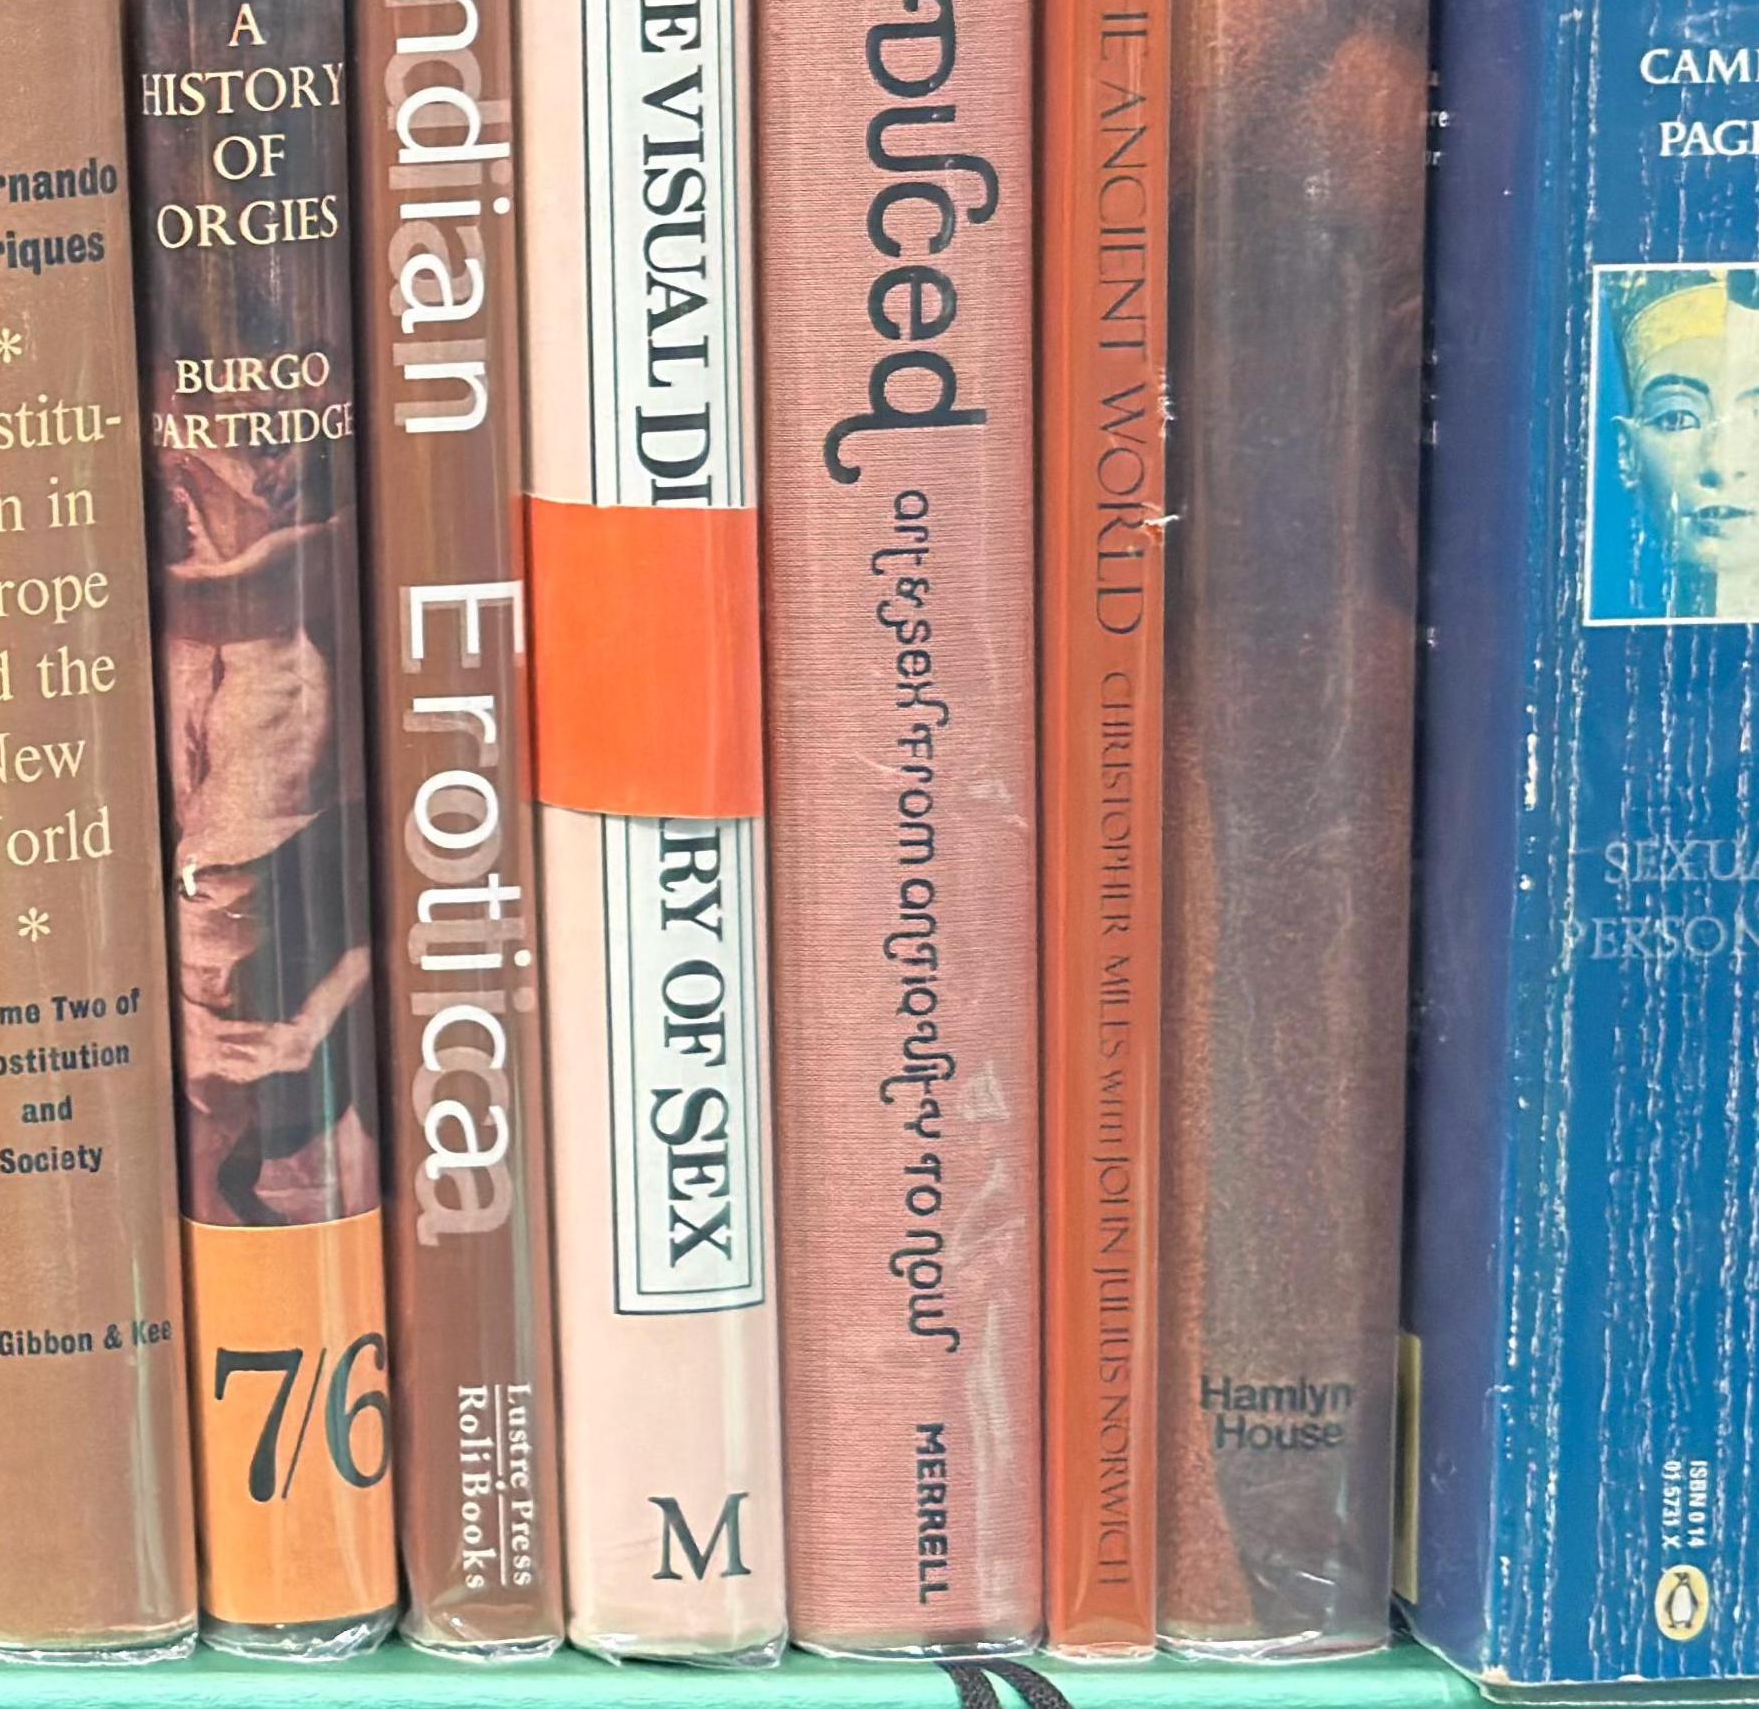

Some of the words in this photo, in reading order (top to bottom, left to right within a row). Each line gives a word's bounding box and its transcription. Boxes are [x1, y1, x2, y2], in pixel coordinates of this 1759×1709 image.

[227, 2, 267, 48] A
[141, 62, 345, 118] HISTORY
[212, 134, 285, 181] OF
[156, 194, 339, 250] ORGIES
[641, 63, 710, 388] VISUAL
[175, 351, 330, 395] BURGO
[48, 476, 96, 529] in
[37, 645, 116, 699] the
[51, 995, 106, 1022] Two
[116, 988, 141, 1016] of
[661, 959, 727, 1067] OF
[21, 1095, 73, 1124] and
[0, 1144, 103, 1175] Society
[650, 1087, 732, 1268] SEX
[103, 1325, 122, 1349] &
[131, 1319, 173, 1345] Kee
[1199, 1374, 1354, 1417] Hamlyn
[458, 1385, 494, 1463] Roli
[507, 1382, 533, 1489] Lustre
[1216, 1413, 1344, 1450] House
[1688, 1460, 1709, 1507] ISBN
[461, 1473, 497, 1589] Books
[648, 1493, 752, 1581] M
[916, 1422, 948, 1605] MERRELL
[511, 1500, 535, 1586] Press
